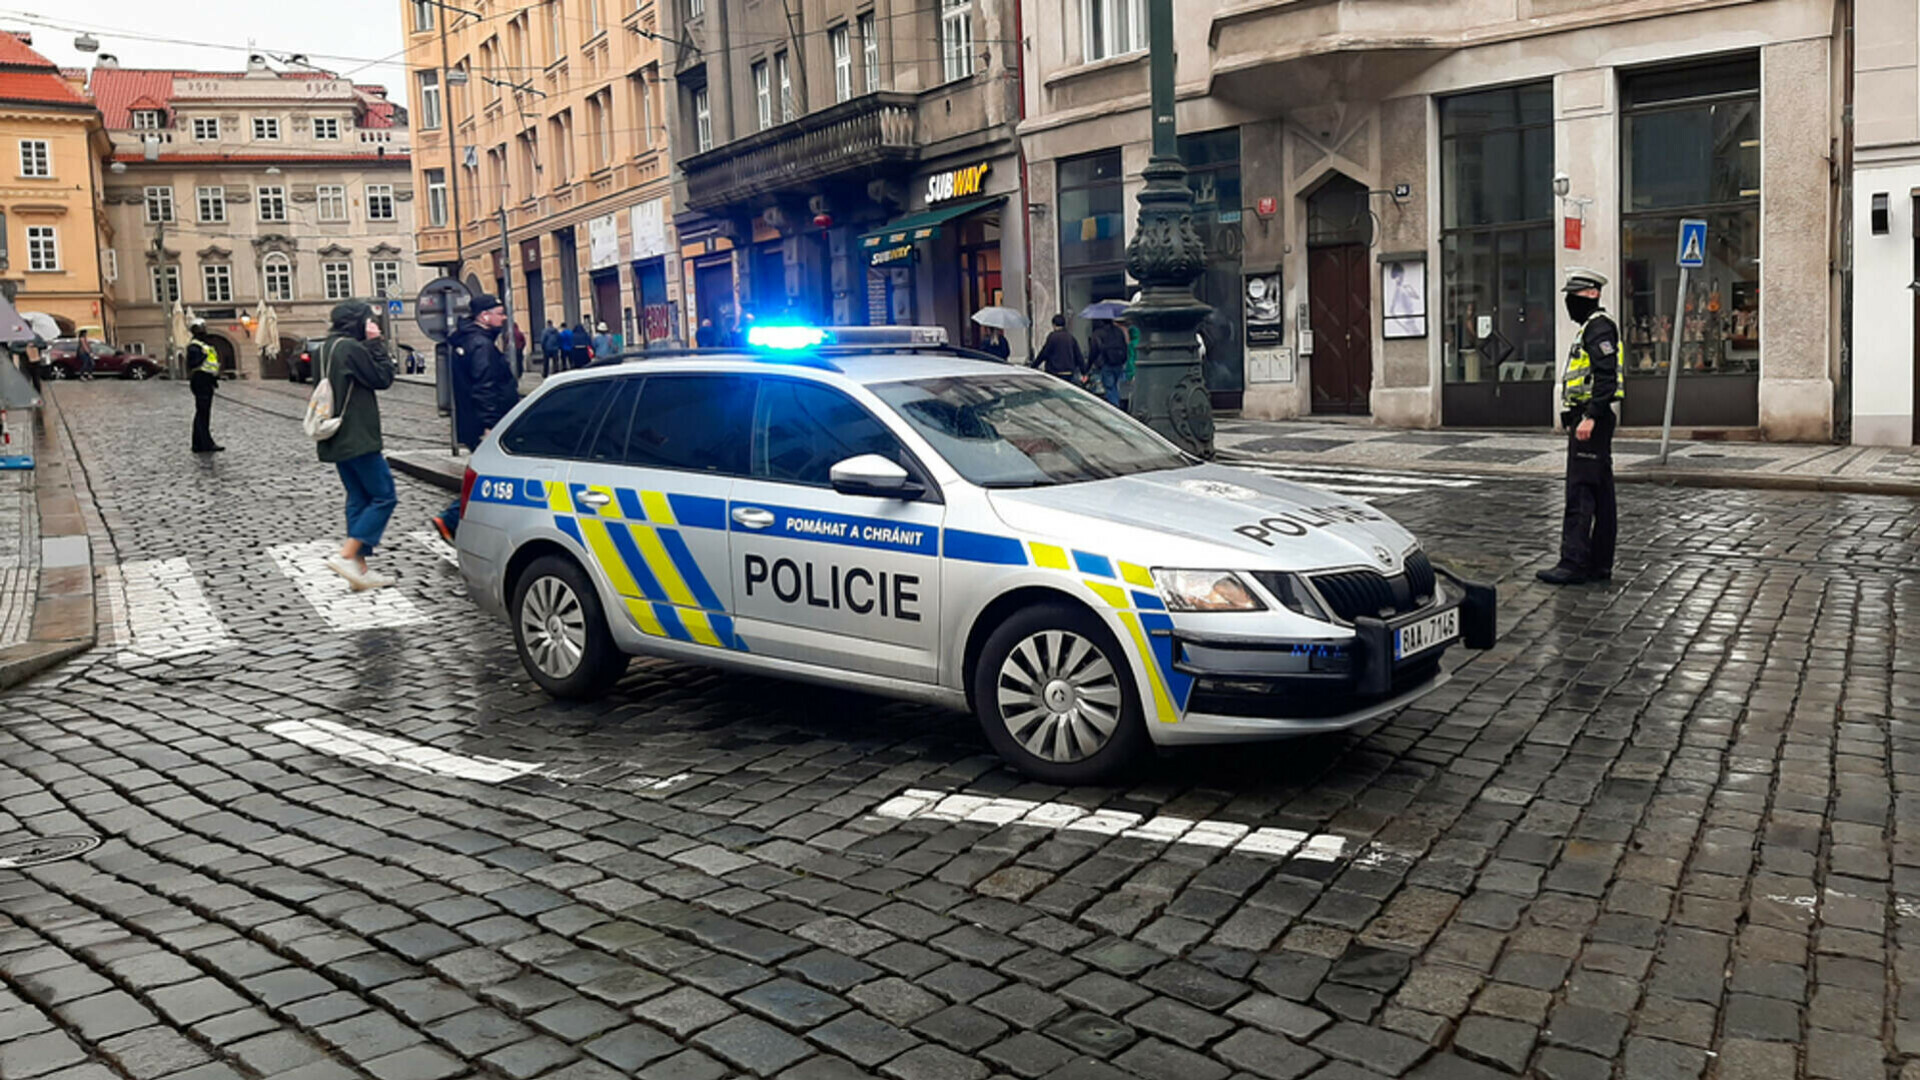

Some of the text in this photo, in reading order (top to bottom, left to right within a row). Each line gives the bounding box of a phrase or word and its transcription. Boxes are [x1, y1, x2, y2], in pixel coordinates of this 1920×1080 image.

[925, 162, 988, 203] SUBWAY
[871, 244, 912, 265] SUBWAY
[493, 482, 513, 499] 158
[786, 517, 923, 545] POMÁHAT A CHRÁNIT
[1233, 505, 1382, 546] POLICIE
[745, 554, 921, 622] POLICIE
